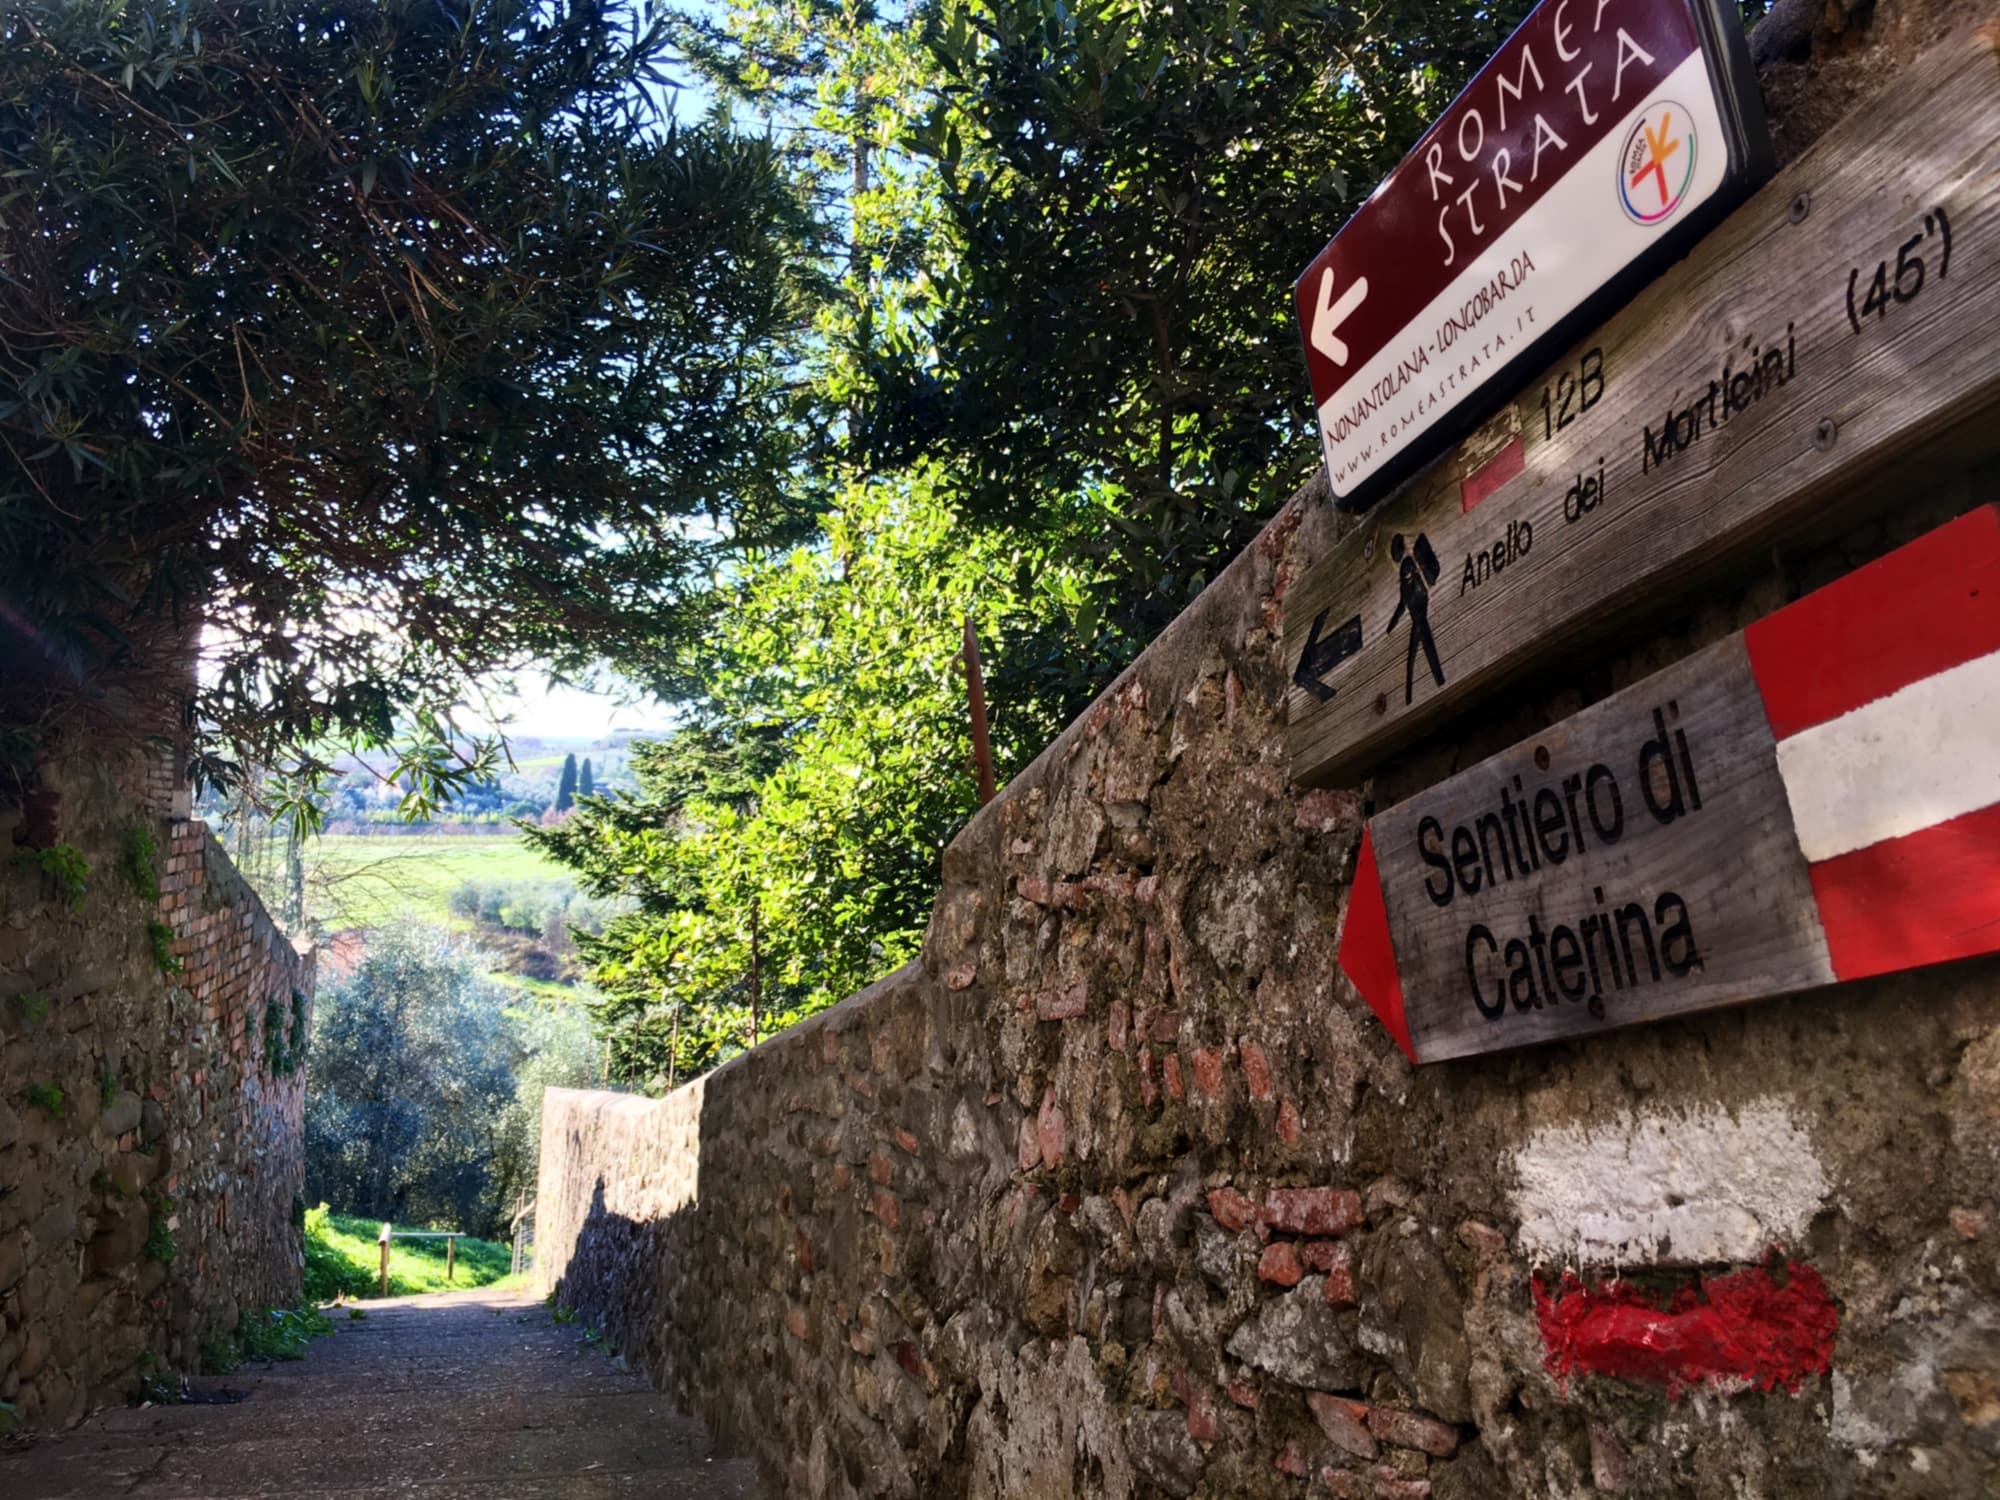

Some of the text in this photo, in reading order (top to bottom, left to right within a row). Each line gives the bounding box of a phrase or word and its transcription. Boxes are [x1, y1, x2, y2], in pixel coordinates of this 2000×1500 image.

[1437, 27, 1655, 267] STRATA
[1335, 307, 1536, 484] WWW.ROMEASTRATA.IT
[1460, 520, 1533, 597] Anello
[1564, 457, 1605, 524] dei
[1846, 207, 1952, 335] (45')
[1541, 347, 1605, 442] 12B
[1417, 700, 1703, 907] Sentiero di
[1465, 887, 1706, 1021] Caterina
